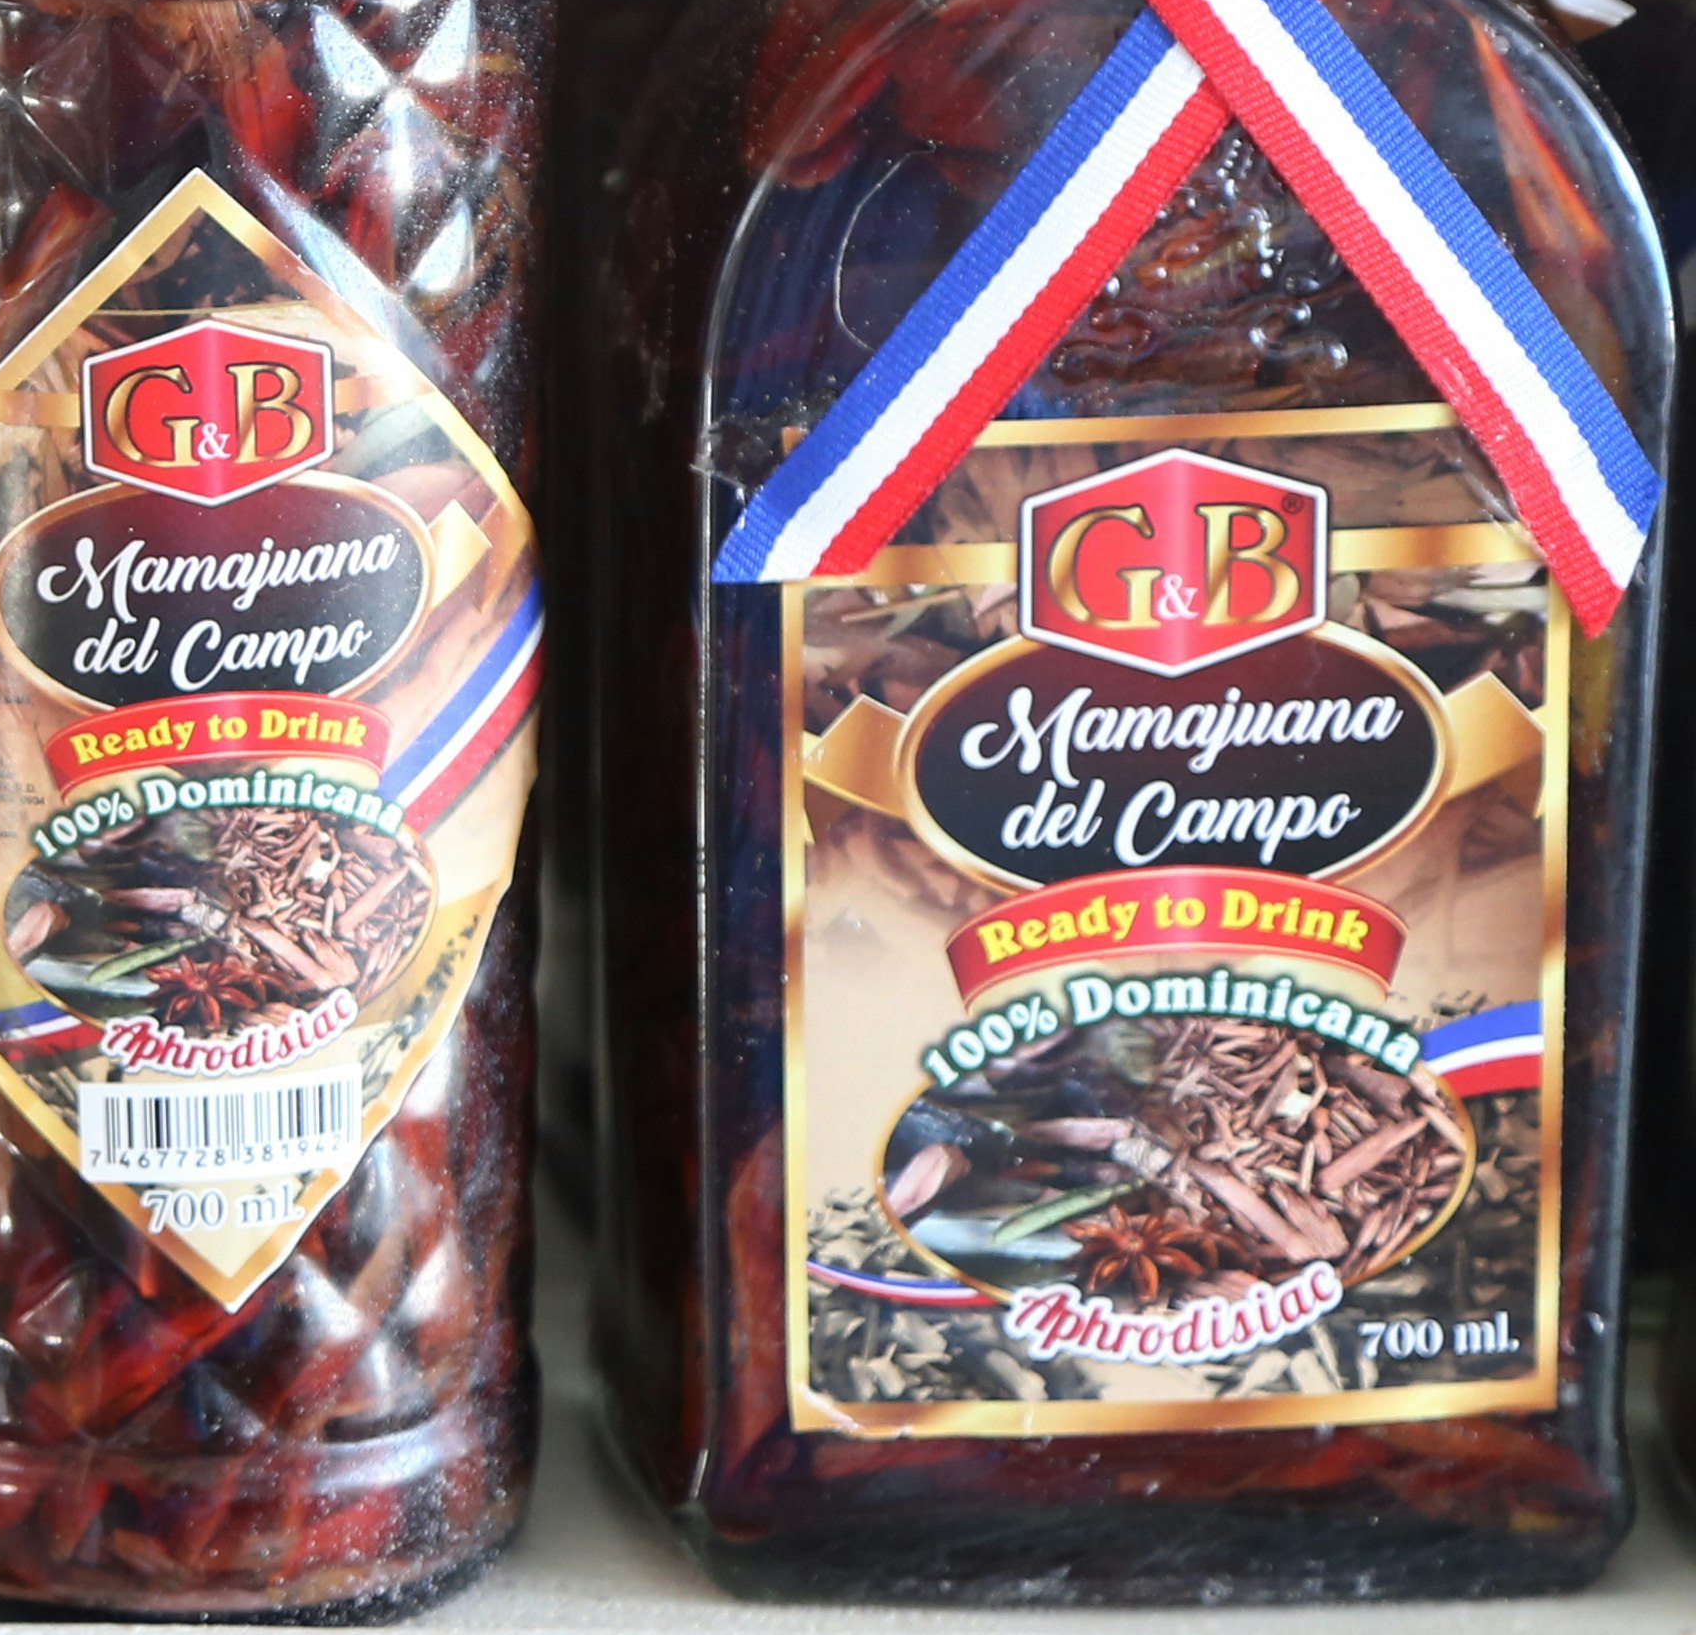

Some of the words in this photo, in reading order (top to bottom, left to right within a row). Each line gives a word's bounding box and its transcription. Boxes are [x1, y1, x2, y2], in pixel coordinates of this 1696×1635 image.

[104, 362, 315, 469] G&B
[37, 525, 401, 625] Mamajuana
[1046, 502, 1301, 631] G&B
[74, 617, 158, 674] del
[172, 613, 372, 691] Campo
[70, 715, 195, 767] Ready
[208, 709, 248, 741] to
[260, 707, 366, 749] Drink
[959, 686, 1404, 787] Mamajuana
[33, 796, 135, 858] 100%
[139, 770, 405, 836] Dominicana
[1002, 780, 1103, 851] del
[1115, 781, 1361, 865] Campo
[976, 892, 1140, 964] Ready
[1153, 892, 1207, 931] to
[1220, 888, 1370, 953] Drink
[102, 988, 358, 1075] Aphrodisiac
[923, 1000, 1058, 1090] 100%
[1069, 969, 1425, 1077] Dominicana
[141, 1188, 226, 1233] 700
[1007, 1261, 1342, 1365] Aphrodisiac
[1359, 1316, 1445, 1361] 700
[1453, 1312, 1520, 1356] ml.
